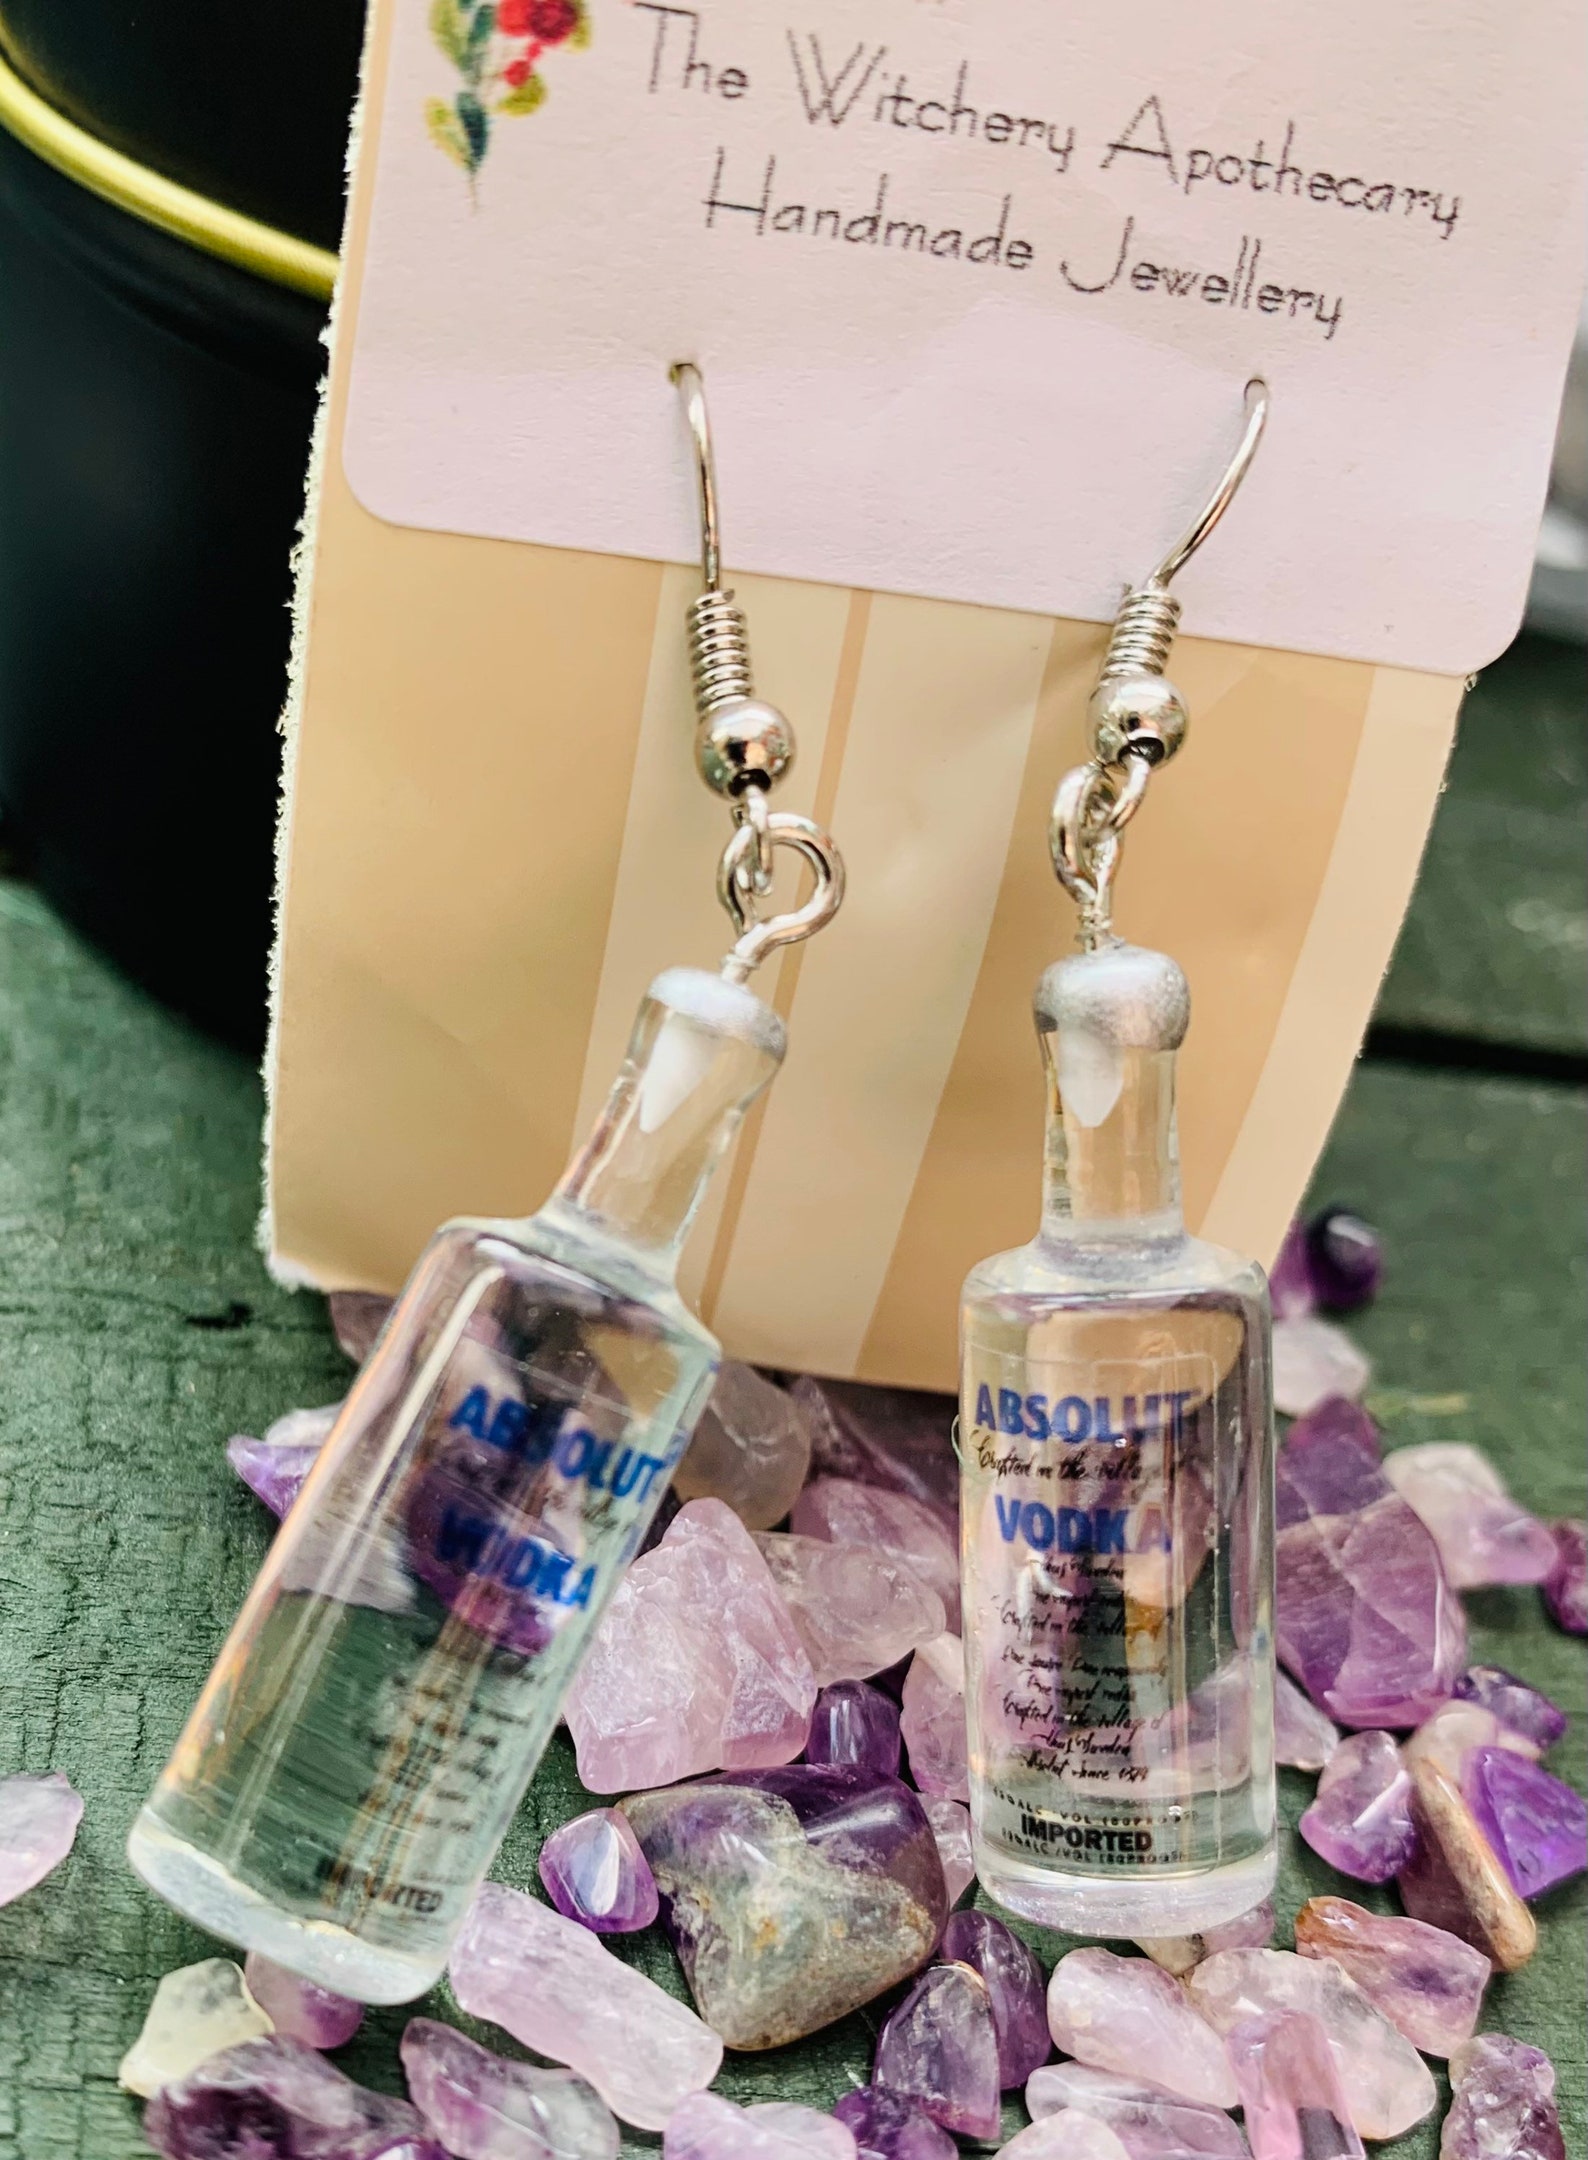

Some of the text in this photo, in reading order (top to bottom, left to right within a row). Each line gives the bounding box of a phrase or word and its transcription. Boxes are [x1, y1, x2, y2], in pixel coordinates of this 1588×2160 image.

[633, 2, 1463, 240] The Witchery Apothecary
[699, 145, 1344, 341] Handmade Jewellery
[974, 1382, 1197, 1443] ABSOLUT
[994, 1494, 1173, 1555] VODKA
[1020, 1813, 1153, 1853] IMPORTED
